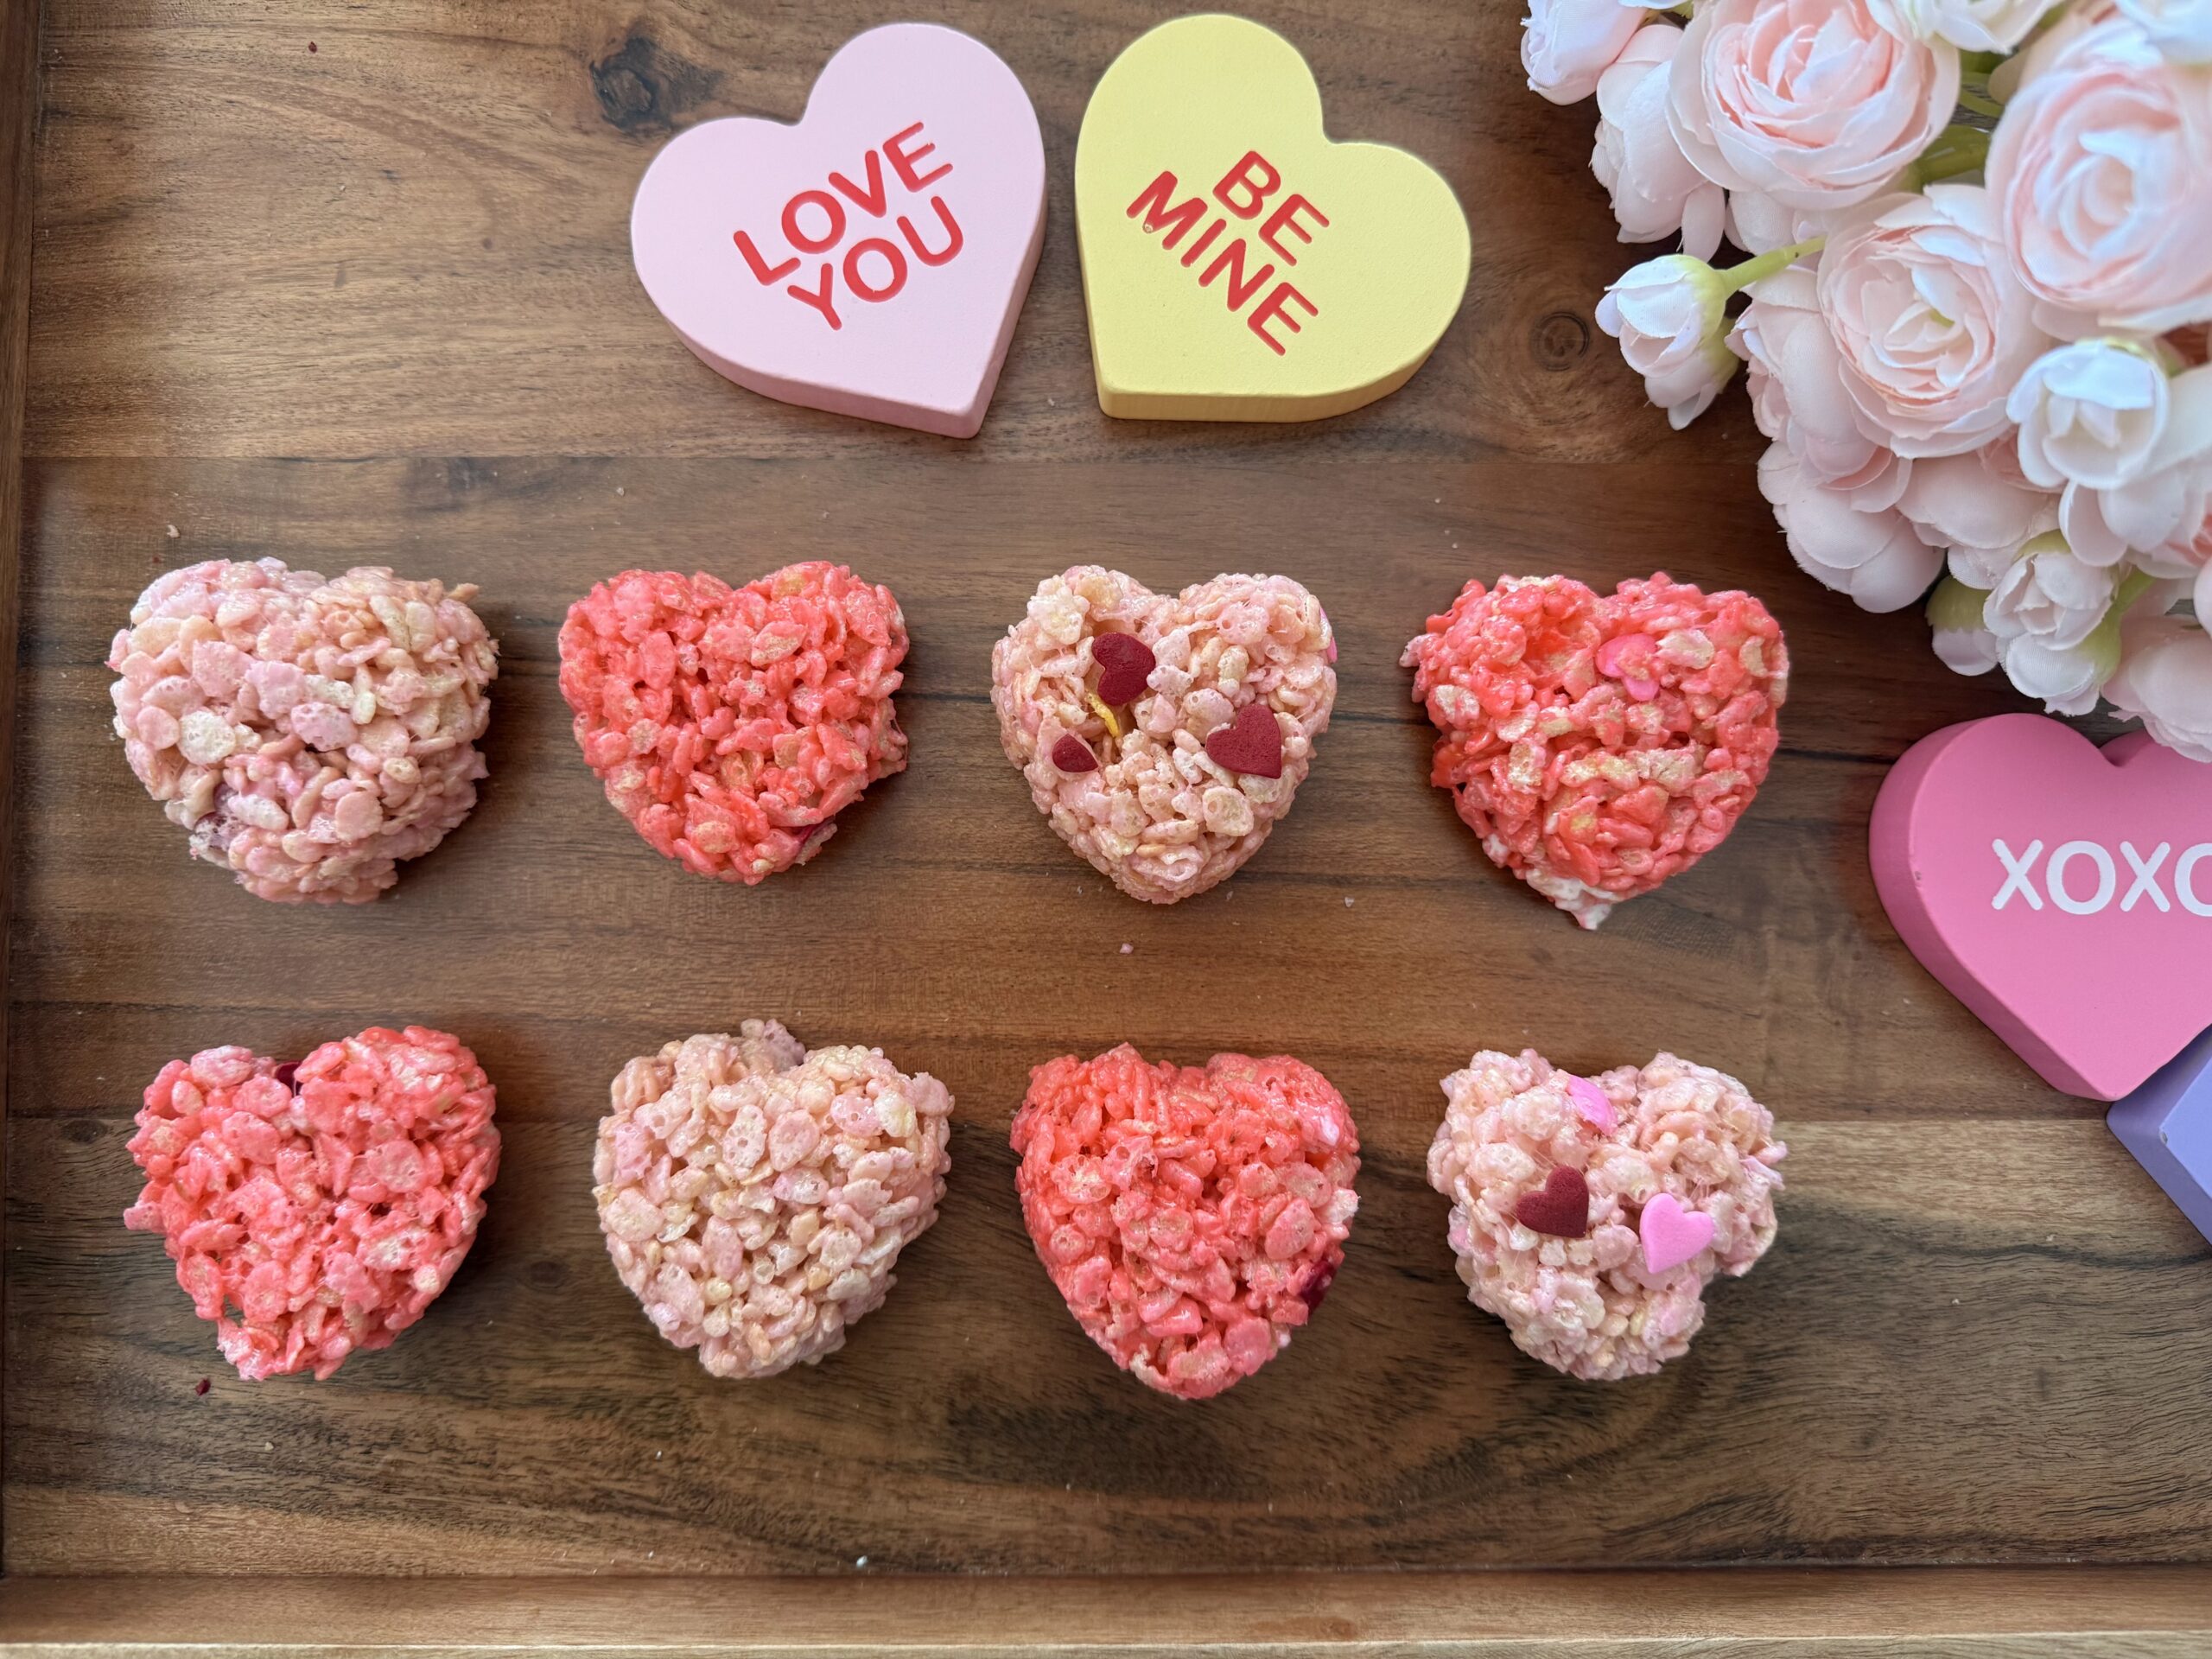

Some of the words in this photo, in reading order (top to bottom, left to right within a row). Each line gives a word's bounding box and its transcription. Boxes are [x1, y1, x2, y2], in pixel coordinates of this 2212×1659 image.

[734, 121, 953, 286] LOVE
[787, 197, 964, 330] YOU
[1126, 170, 1319, 355] MINE
[1212, 149, 1330, 266] BE
